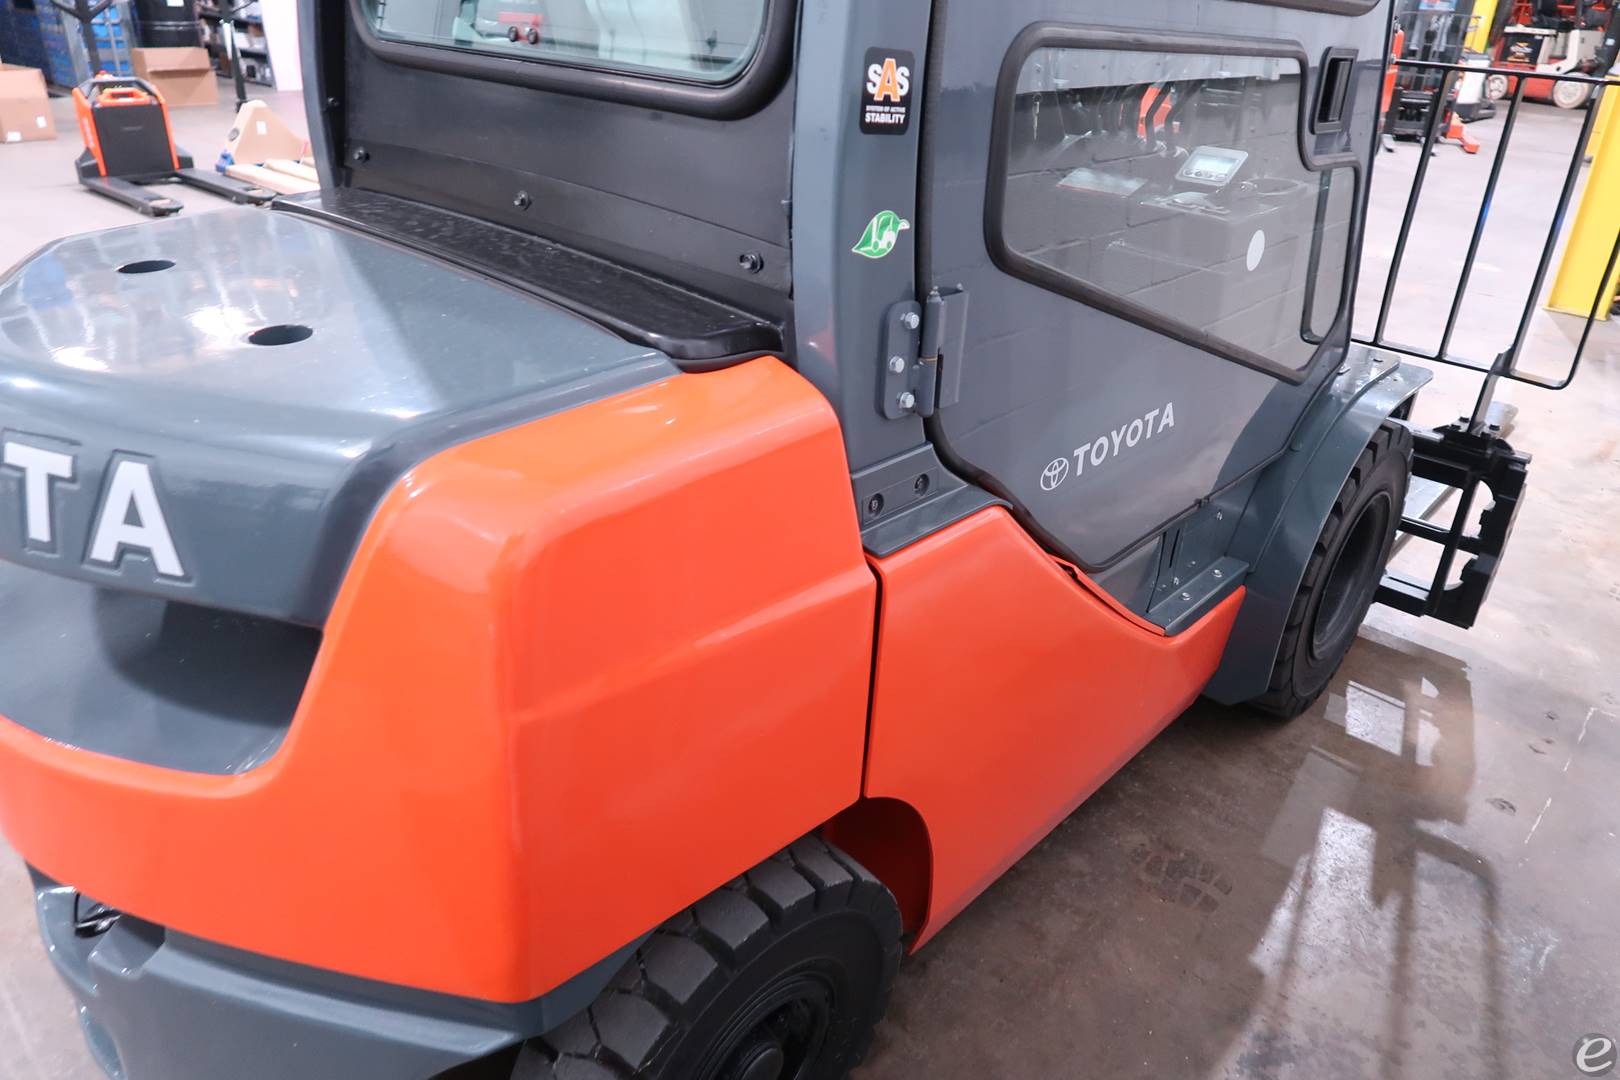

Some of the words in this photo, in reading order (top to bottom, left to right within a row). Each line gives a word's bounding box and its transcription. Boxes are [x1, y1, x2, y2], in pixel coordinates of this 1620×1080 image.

[866, 58, 910, 102] SAS
[865, 112, 906, 124] STABILITY
[1073, 402, 1175, 476] TOYOTA
[3, 441, 185, 577] TA
